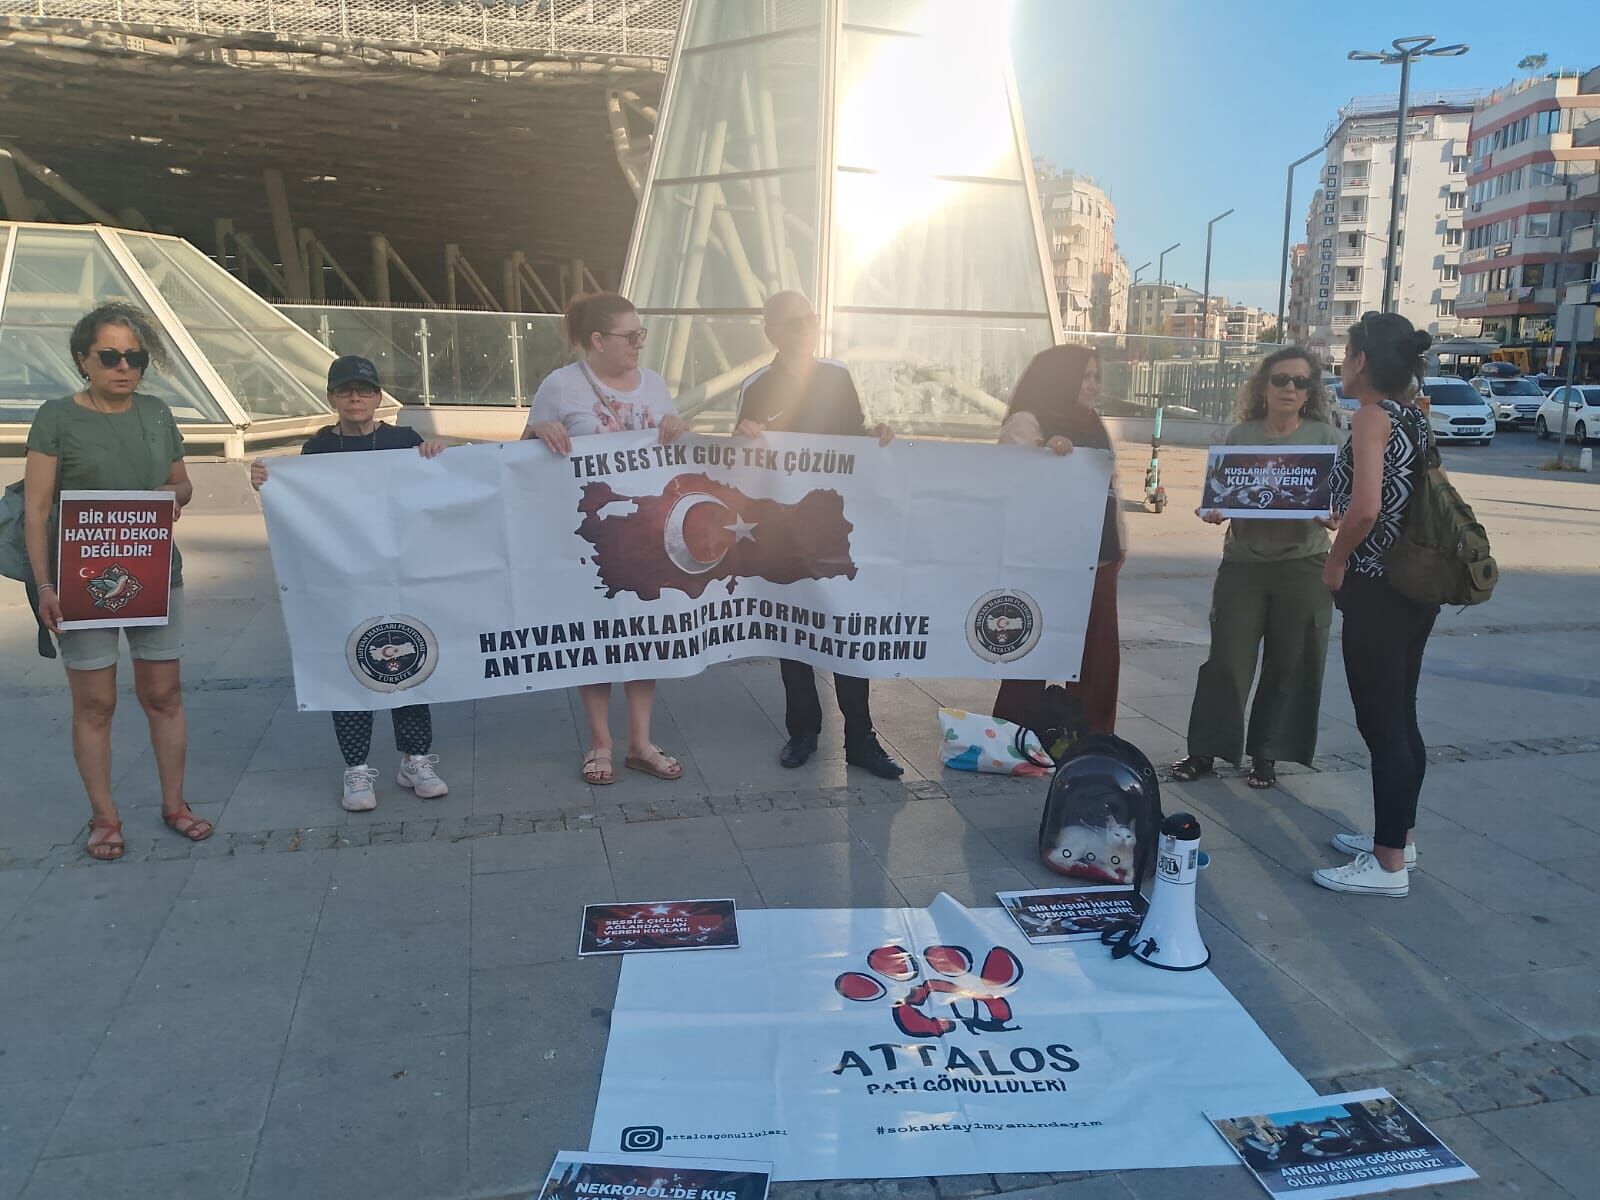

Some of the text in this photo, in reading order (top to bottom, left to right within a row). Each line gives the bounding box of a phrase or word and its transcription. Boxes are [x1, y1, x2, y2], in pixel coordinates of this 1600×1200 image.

[570, 445, 856, 478] TEK SES TEK GÜÇ TEK ÇÖZÜM
[1225, 467, 1269, 477] KUŞLARIN
[1227, 475, 1314, 486] KULAK VERİN
[79, 508, 157, 526] BİR KUŞUN
[65, 528, 169, 541] HAYATI DEKOR
[80, 542, 153, 558] DEĞİLDİR!
[479, 598, 930, 653] HAYVAN HAKLARI PLATFORMU TÜRKİYE
[484, 621, 927, 679] ANTALYA HAYVAN HAKLARI PLATFORMU
[1028, 899, 1132, 913] BİR KUŞUN HAYATI
[1036, 907, 1135, 919] DEKOR DEĞİLDİR!
[605, 917, 644, 926] SESSİZ
[603, 928, 643, 936] VEREN
[832, 1043, 1080, 1077] ATTALOS
[1281, 1148, 1432, 1176] ANTALYA'NIN GÖĞÜNDE
[1286, 1174, 1327, 1187] ÖLÜM
[1328, 1170, 1352, 1182] AĞI
[575, 1182, 698, 1199] NEKROPOL'DE
